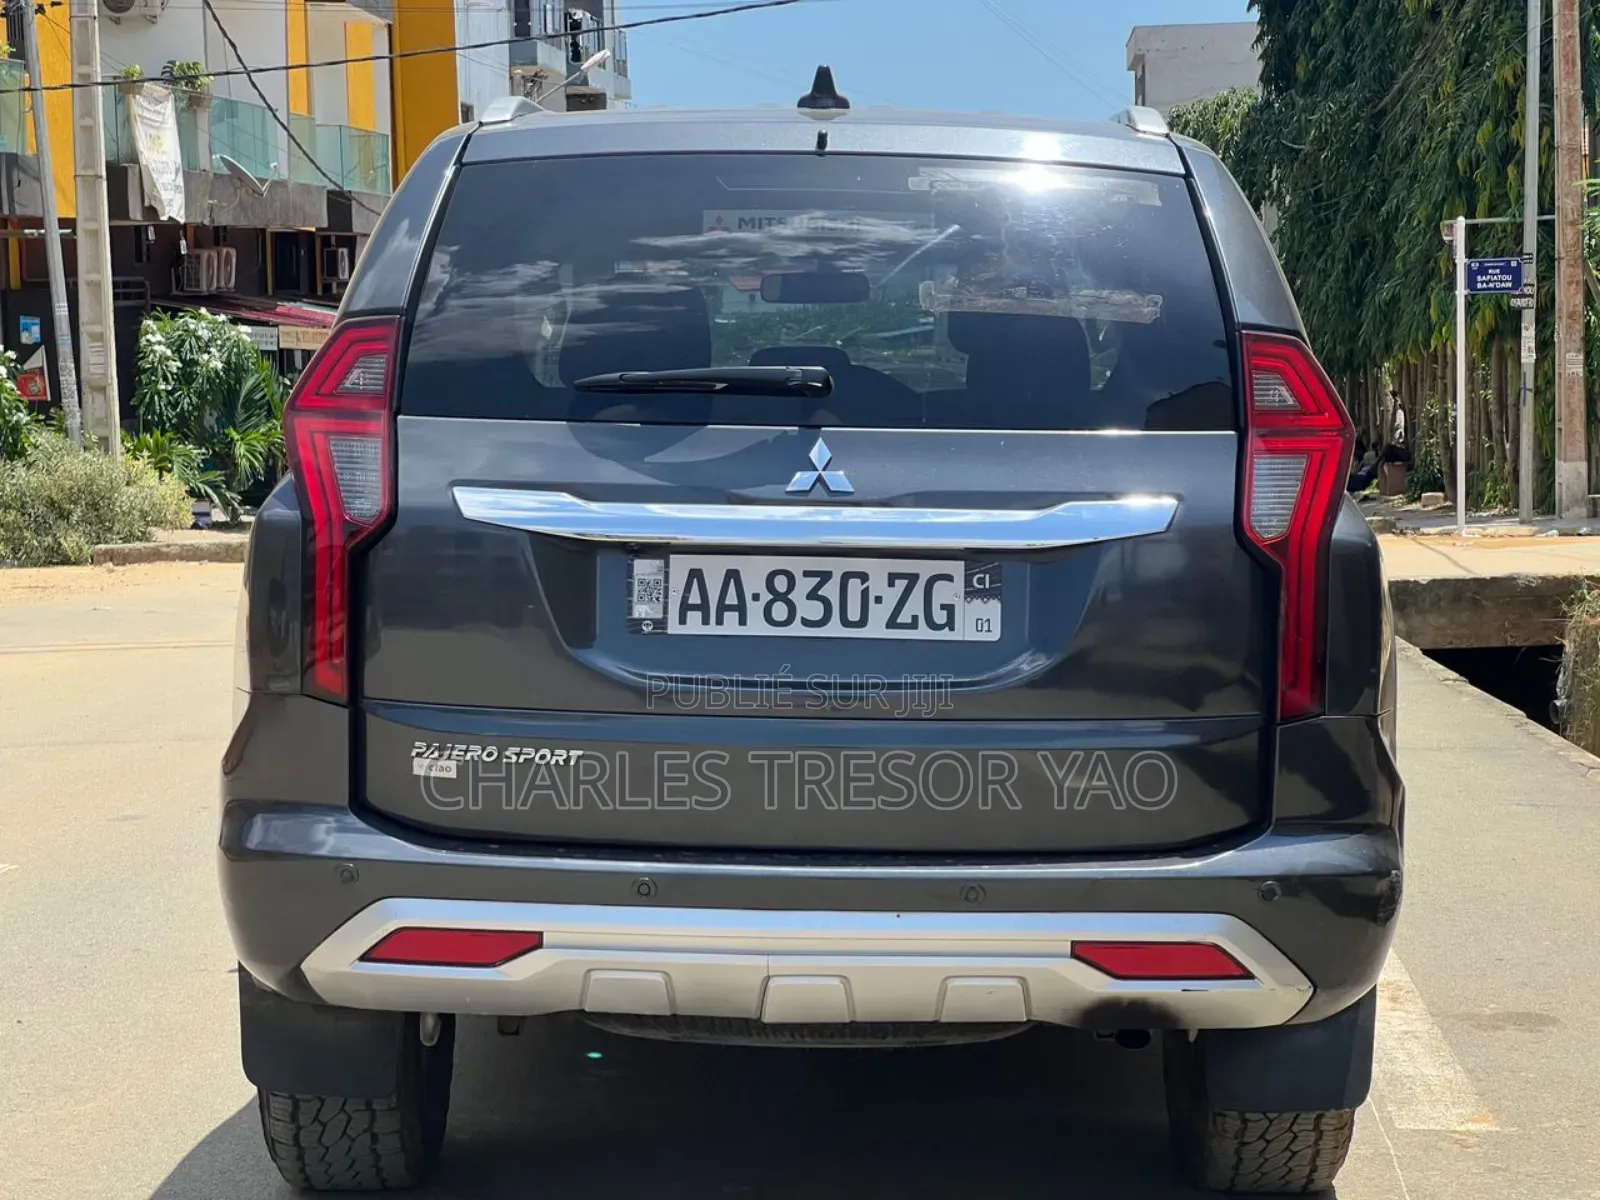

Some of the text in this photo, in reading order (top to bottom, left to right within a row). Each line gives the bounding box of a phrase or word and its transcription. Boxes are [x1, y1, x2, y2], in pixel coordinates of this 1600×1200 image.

[972, 573, 990, 589] CI
[975, 618, 992, 633] 01
[410, 741, 583, 766] PAJERO SPORT
